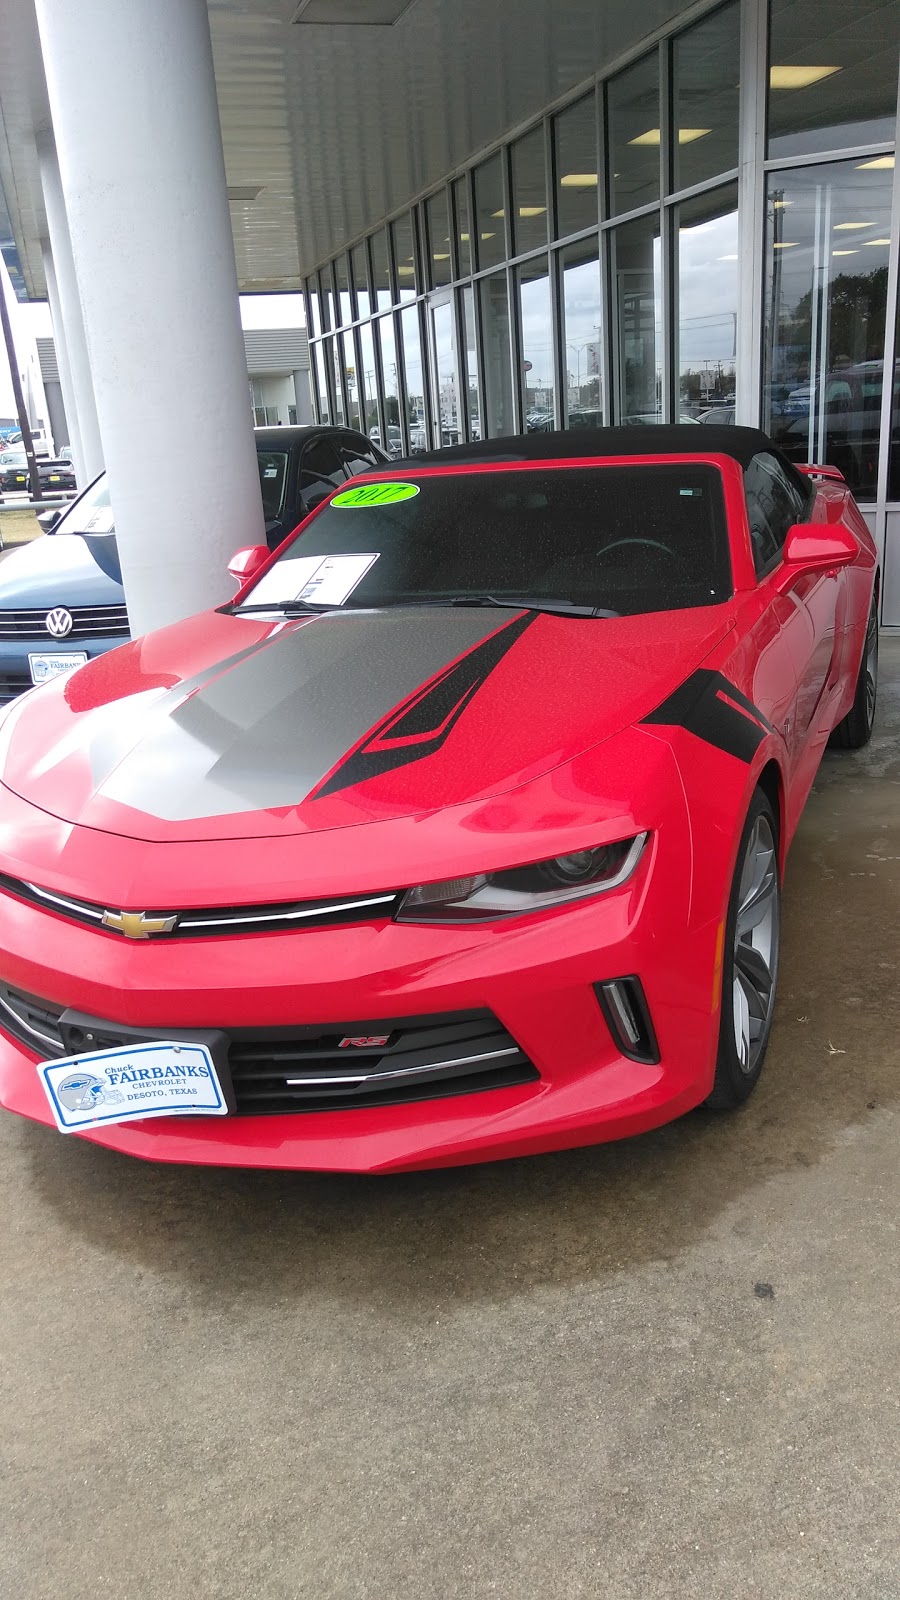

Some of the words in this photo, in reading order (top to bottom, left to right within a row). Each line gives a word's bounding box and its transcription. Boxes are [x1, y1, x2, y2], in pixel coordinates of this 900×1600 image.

[340, 487, 409, 504] 2017
[338, 1035, 390, 1048] RS
[104, 1063, 134, 1075] Chuck
[107, 1065, 209, 1086] FAIRBANKS
[132, 1078, 187, 1090] CHEVROLET
[126, 1089, 168, 1101] DESOTO,
[168, 1087, 198, 1096] TEXAS
